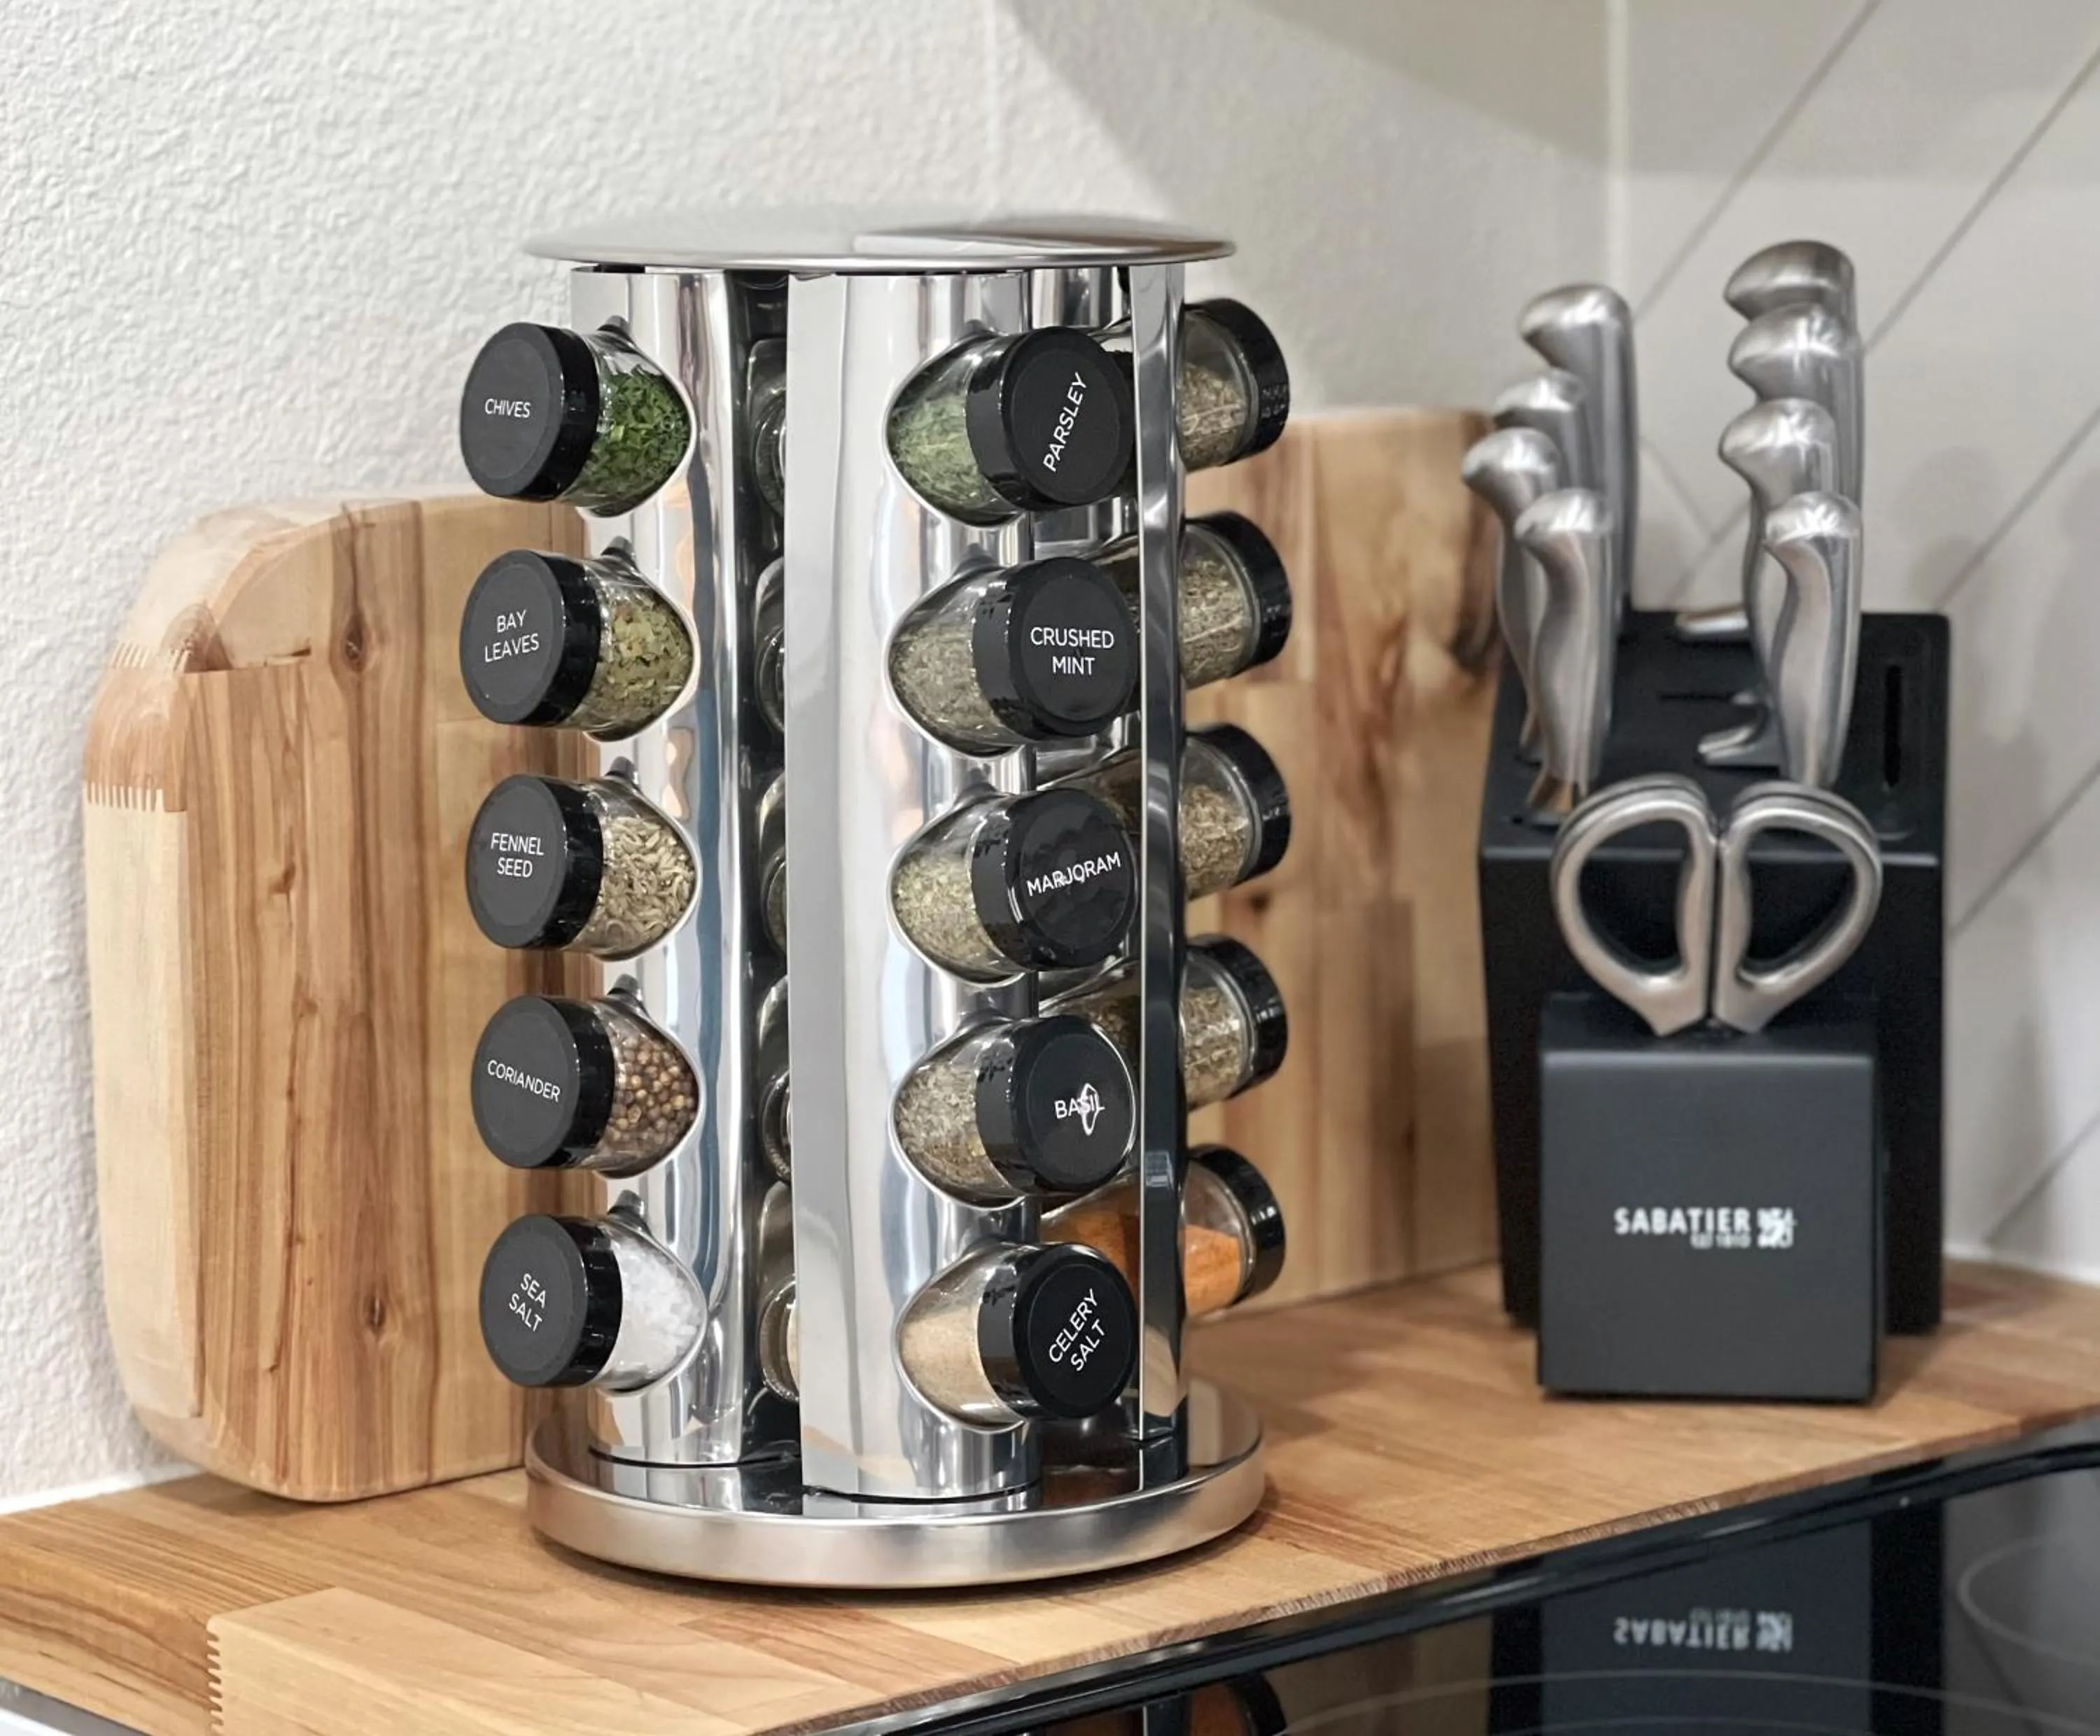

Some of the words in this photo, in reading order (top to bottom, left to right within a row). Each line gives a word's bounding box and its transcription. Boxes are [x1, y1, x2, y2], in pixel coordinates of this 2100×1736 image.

[484, 398, 532, 419] CHIVES
[1042, 372, 1087, 472] PARSLEY
[496, 608, 527, 634] BAY
[484, 632, 540, 663] LEAVES
[1030, 626, 1115, 649] CRUSHED
[1052, 655, 1096, 676] MINT
[490, 832, 545, 857] FENNEL
[496, 856, 533, 878] SEED
[1026, 851, 1121, 897] MARJORAM
[486, 1059, 561, 1103] CORIANDER
[1614, 1207, 1752, 1236] SABATIER
[520, 1273, 547, 1309] SEA
[508, 1292, 543, 1332] SALT
[1049, 1288, 1098, 1363] CELERY
[1070, 1318, 1105, 1371] SALT
